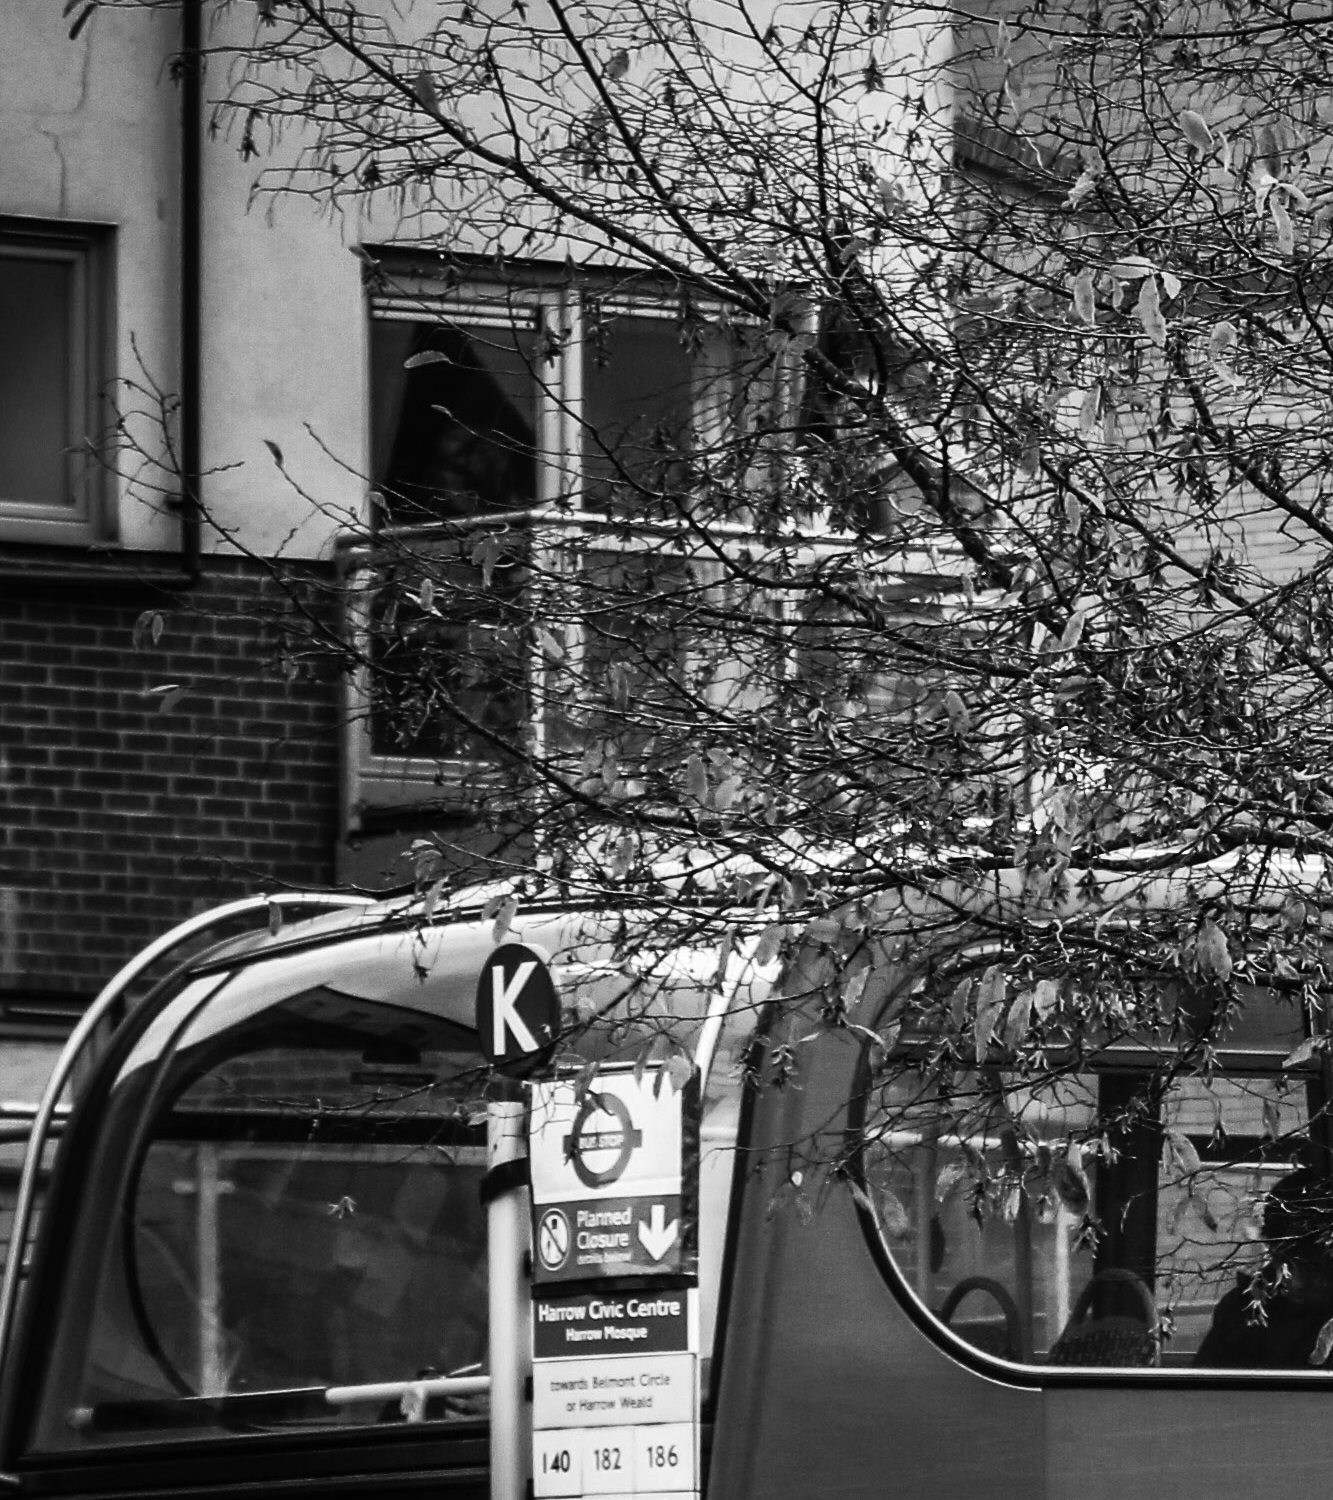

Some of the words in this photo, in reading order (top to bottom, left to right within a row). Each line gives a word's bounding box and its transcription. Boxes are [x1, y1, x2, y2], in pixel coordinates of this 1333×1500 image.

[492, 962, 539, 1056] K
[577, 1207, 631, 1227] Planned
[577, 1231, 629, 1250] Closure
[538, 1303, 586, 1322] Harrow
[589, 1301, 624, 1320] Civic
[627, 1299, 680, 1317] Centre
[566, 1328, 602, 1342] Harrow
[604, 1326, 648, 1341] Mosque
[550, 1378, 588, 1391] towards
[592, 1376, 635, 1389] Belmont
[640, 1373, 671, 1387] Circle
[566, 1403, 576, 1412] or
[579, 1399, 615, 1411] Harrow
[620, 1397, 653, 1409] Weald
[542, 1450, 570, 1474] 140
[594, 1448, 621, 1471] 182
[647, 1445, 678, 1468] 186
